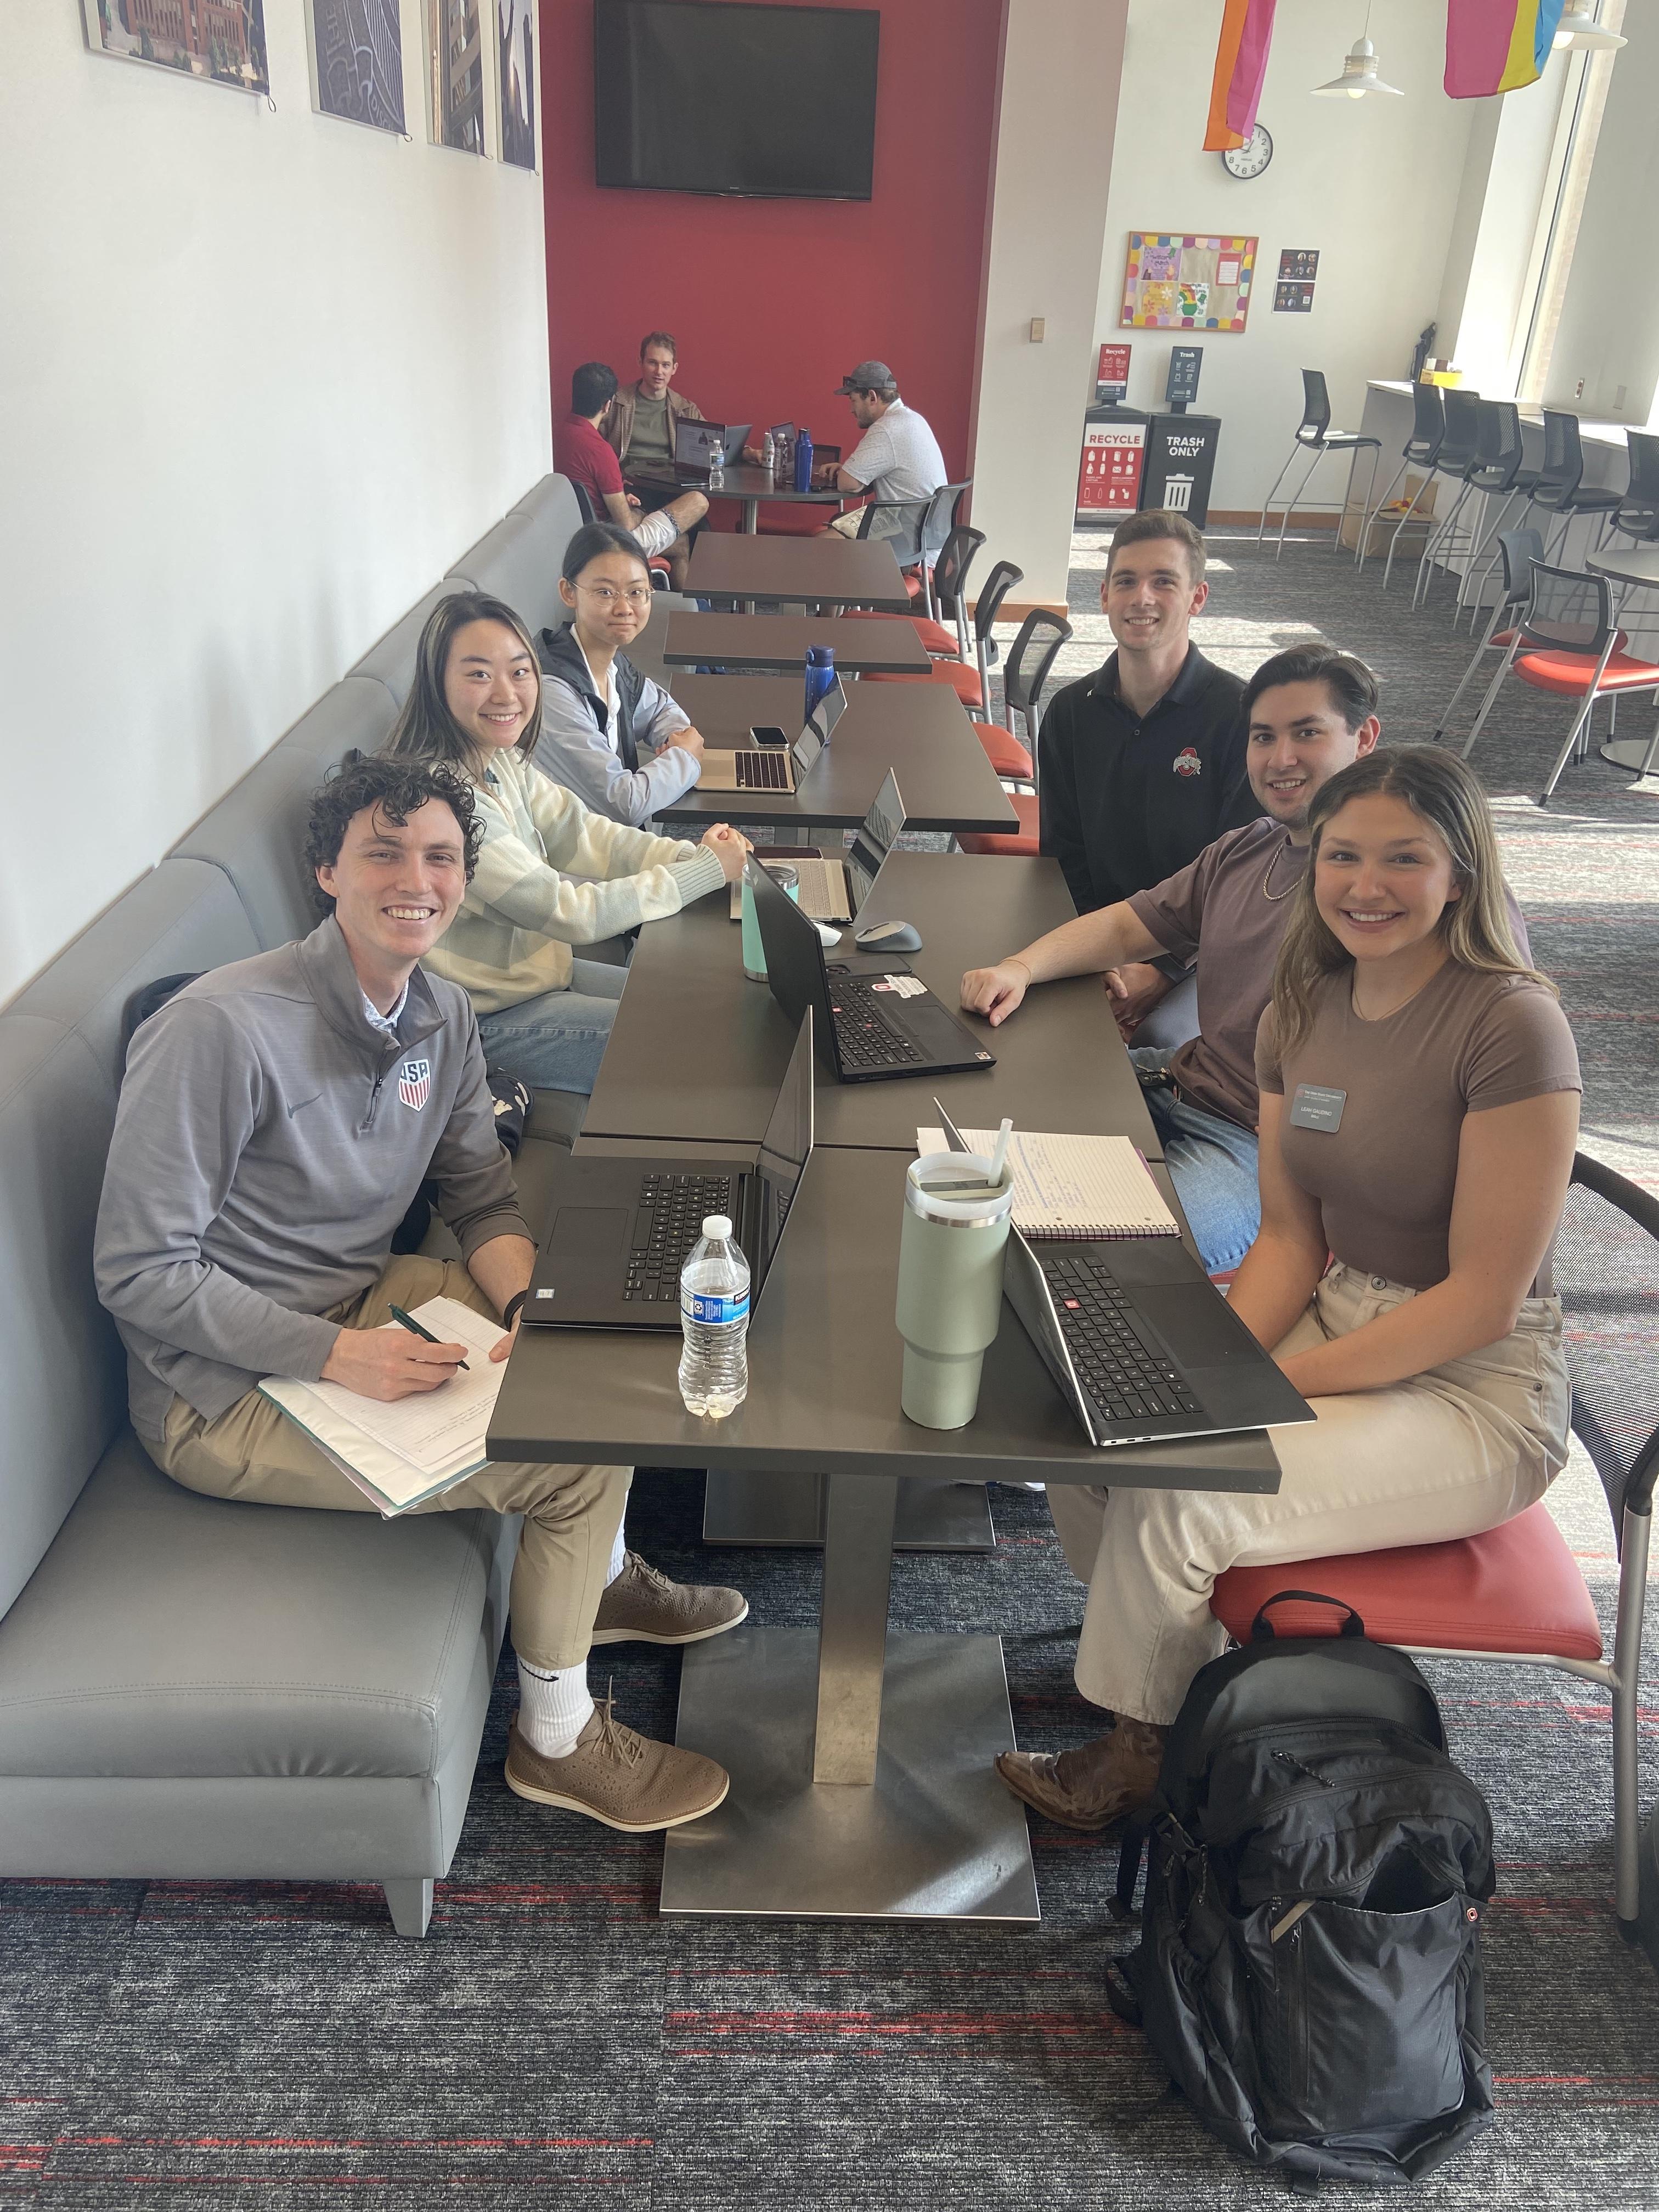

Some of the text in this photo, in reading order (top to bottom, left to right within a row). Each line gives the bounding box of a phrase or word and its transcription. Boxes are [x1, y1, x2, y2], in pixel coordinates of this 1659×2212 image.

[1090, 435, 1141, 444] RECYCLE
[1166, 436, 1205, 447] TRASH
[1169, 447, 1199, 456] ONLY
